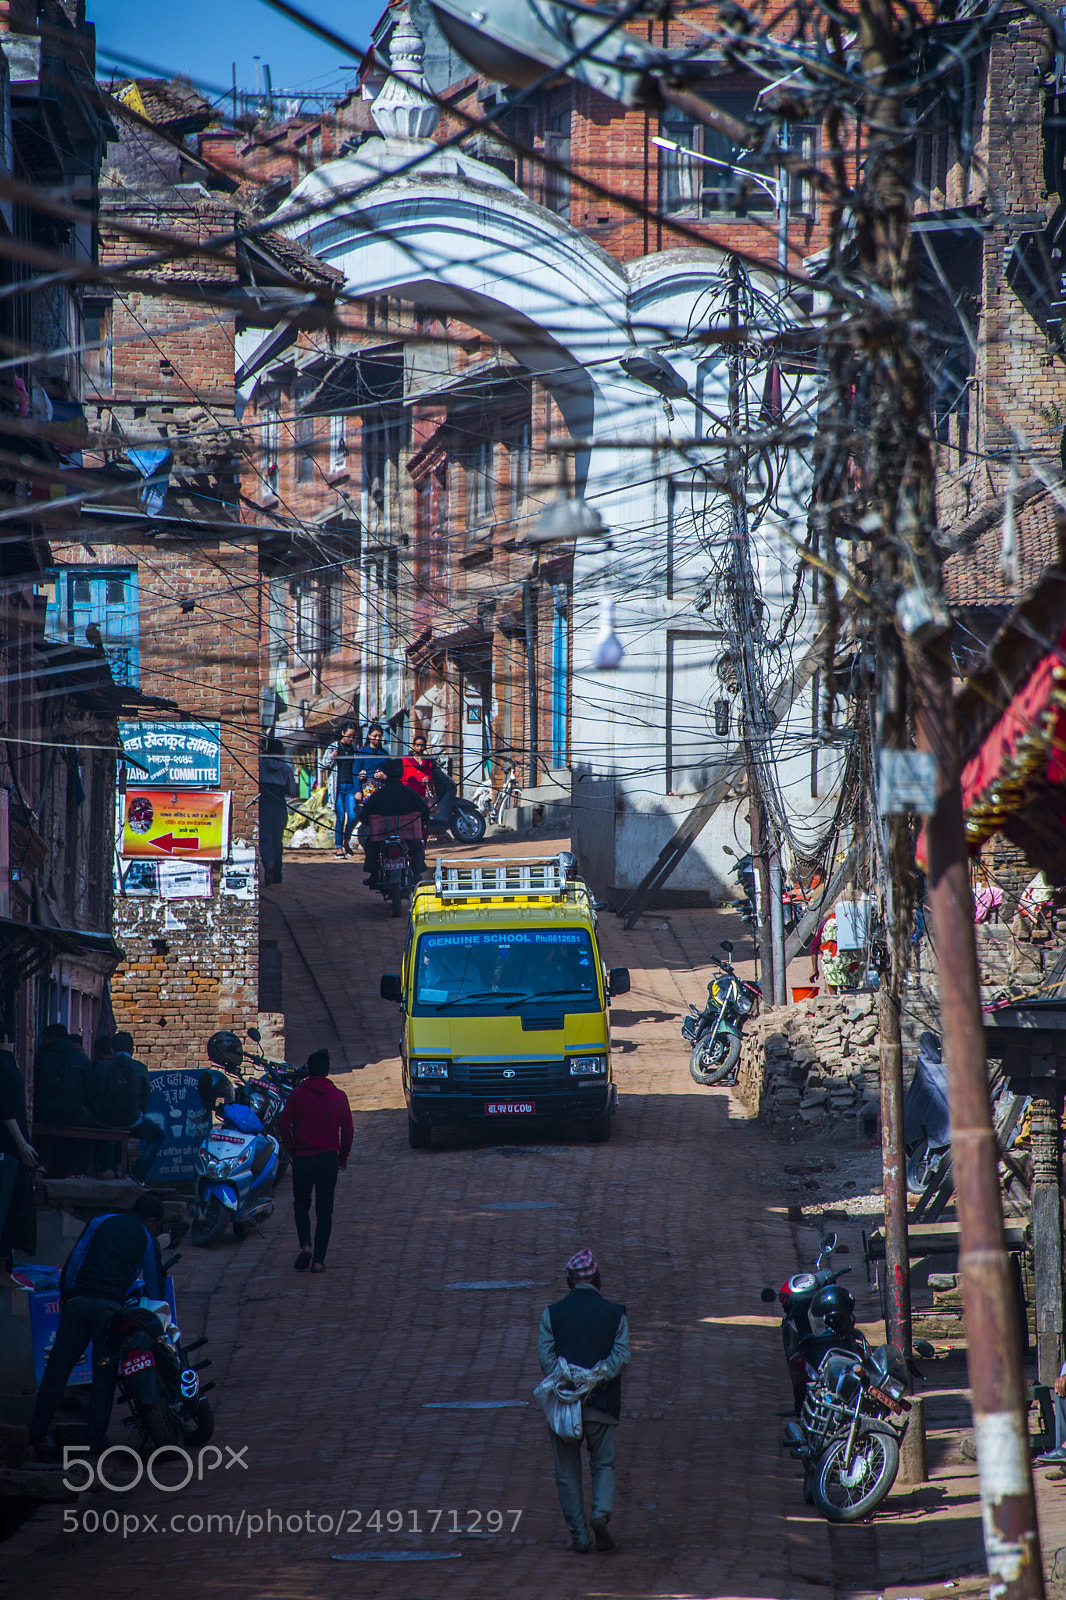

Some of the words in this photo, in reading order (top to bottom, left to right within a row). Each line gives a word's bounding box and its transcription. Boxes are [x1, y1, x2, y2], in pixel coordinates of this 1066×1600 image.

[169, 768, 217, 780] COMMITTEE
[428, 935, 480, 947] GENUINE
[483, 934, 531, 943] SCHOOL
[535, 934, 580, 943] Ph:6612651
